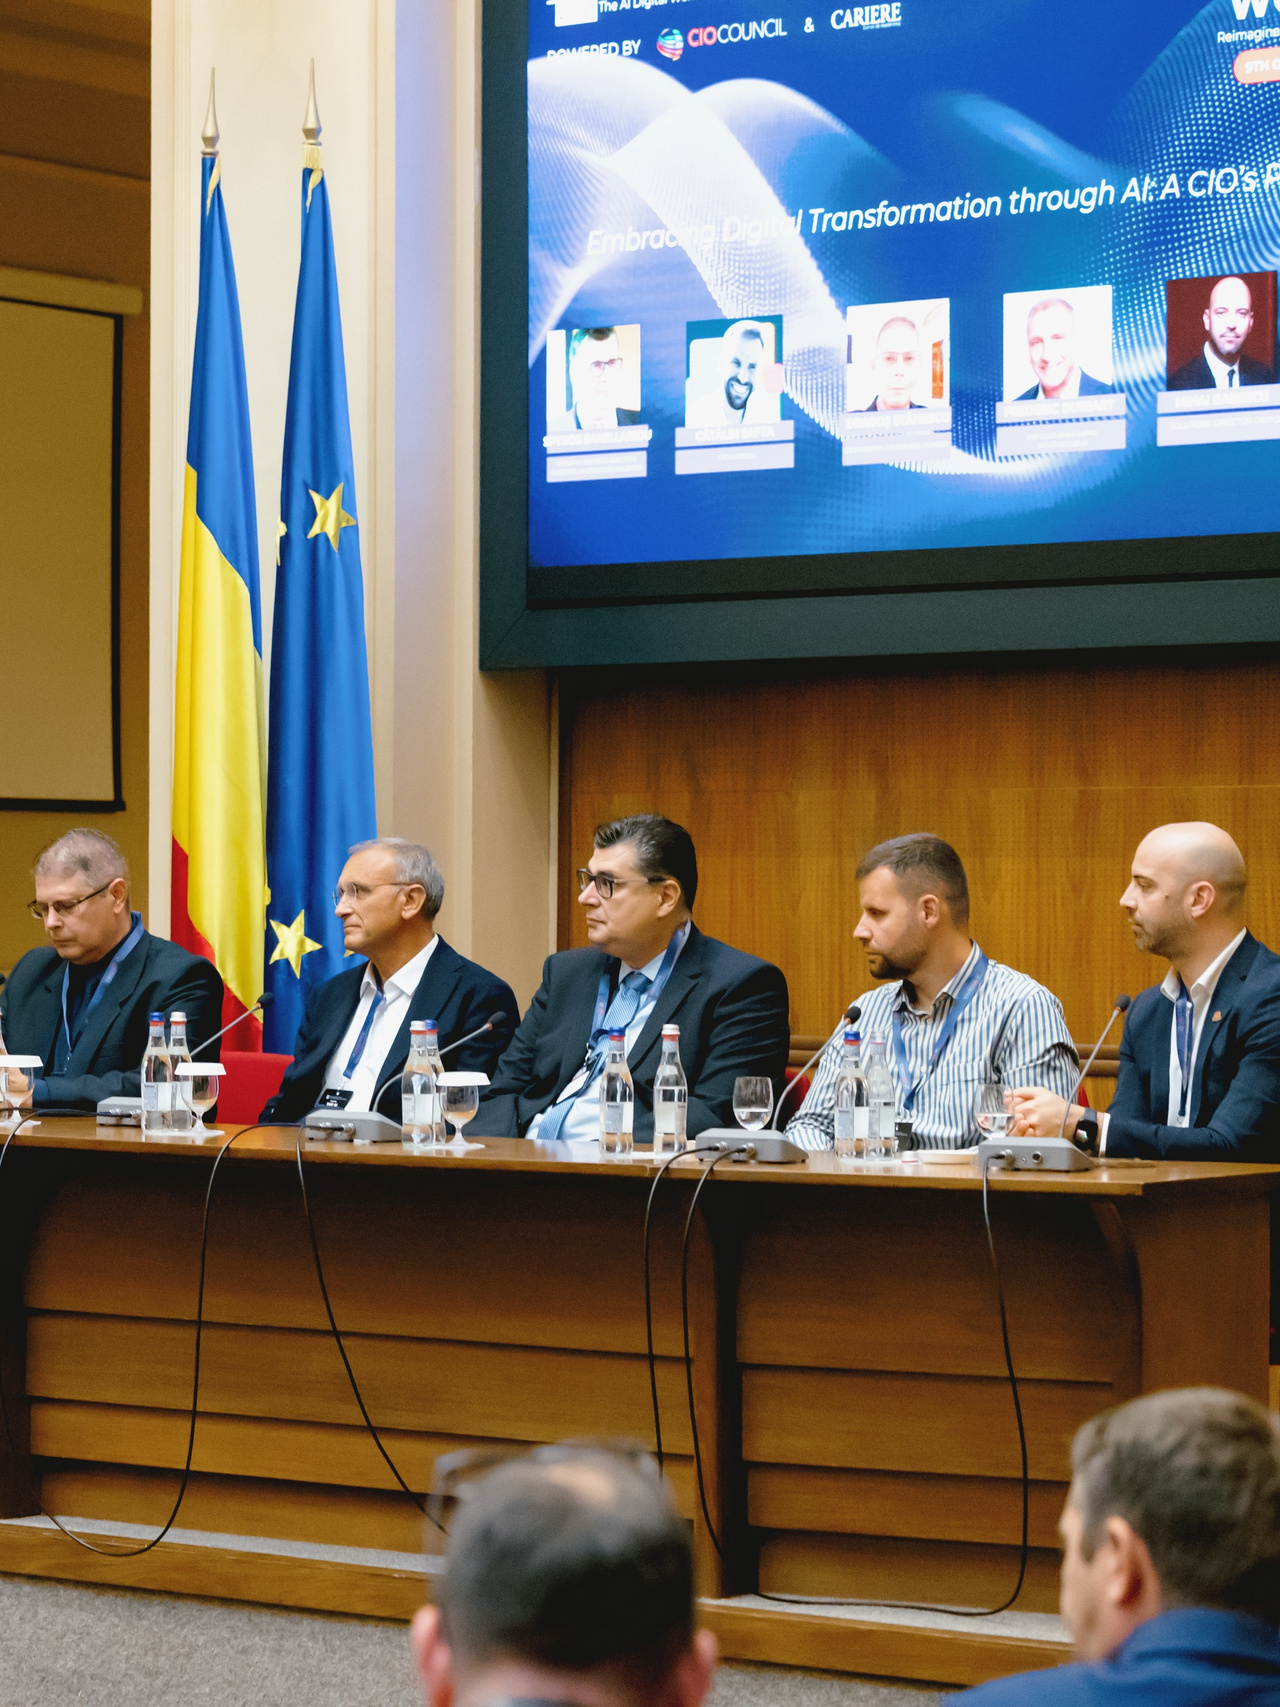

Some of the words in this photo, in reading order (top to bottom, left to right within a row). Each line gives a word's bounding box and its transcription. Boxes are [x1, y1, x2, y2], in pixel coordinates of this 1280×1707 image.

[546, 42, 619, 61] POWERED
[622, 39, 641, 56] BY
[803, 16, 815, 33] &
[830, 2, 902, 30] CARIERE
[587, 221, 715, 256] Embracing
[722, 209, 803, 245] Digital
[808, 192, 1002, 234] Transformation
[1009, 179, 1116, 214] through
[1120, 177, 1156, 203] AI:
[1159, 173, 1181, 200] A
